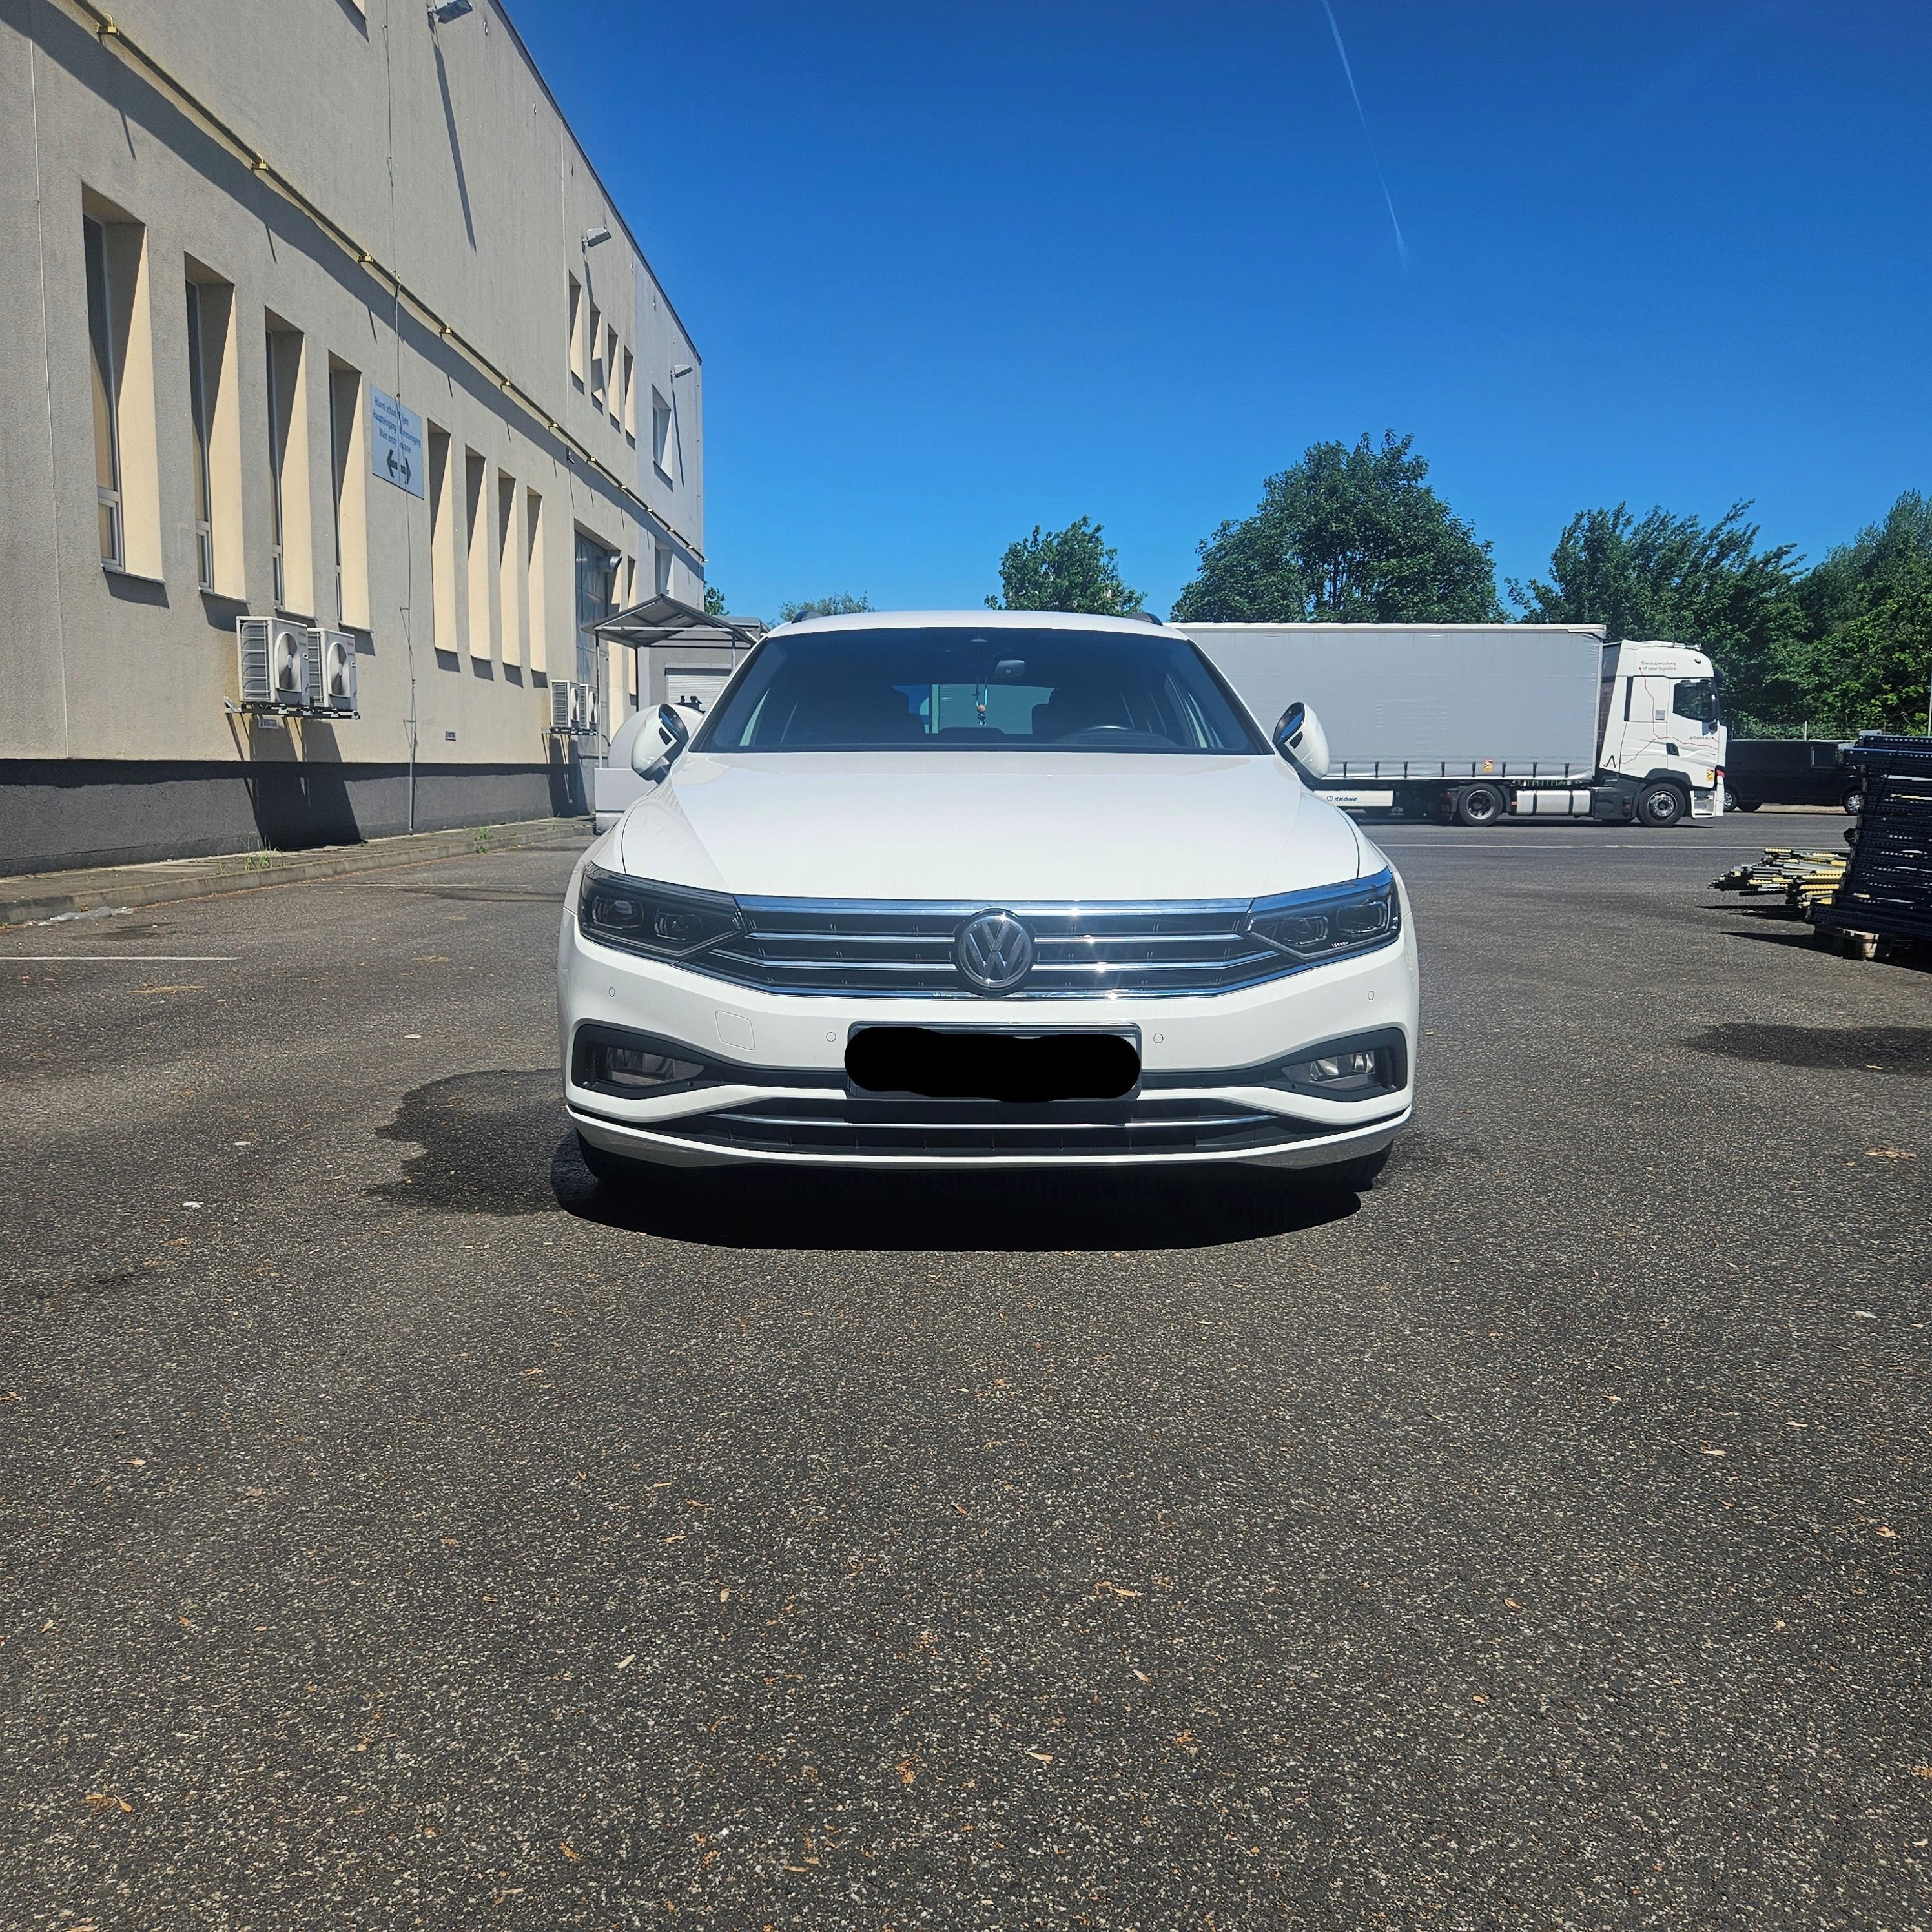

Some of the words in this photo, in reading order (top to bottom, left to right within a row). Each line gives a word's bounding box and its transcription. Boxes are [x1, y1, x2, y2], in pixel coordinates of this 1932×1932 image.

[373, 409, 397, 434] Haupteingang
[386, 406, 396, 418] vchod
[379, 427, 388, 440] Main
[388, 435, 397, 447] entry
